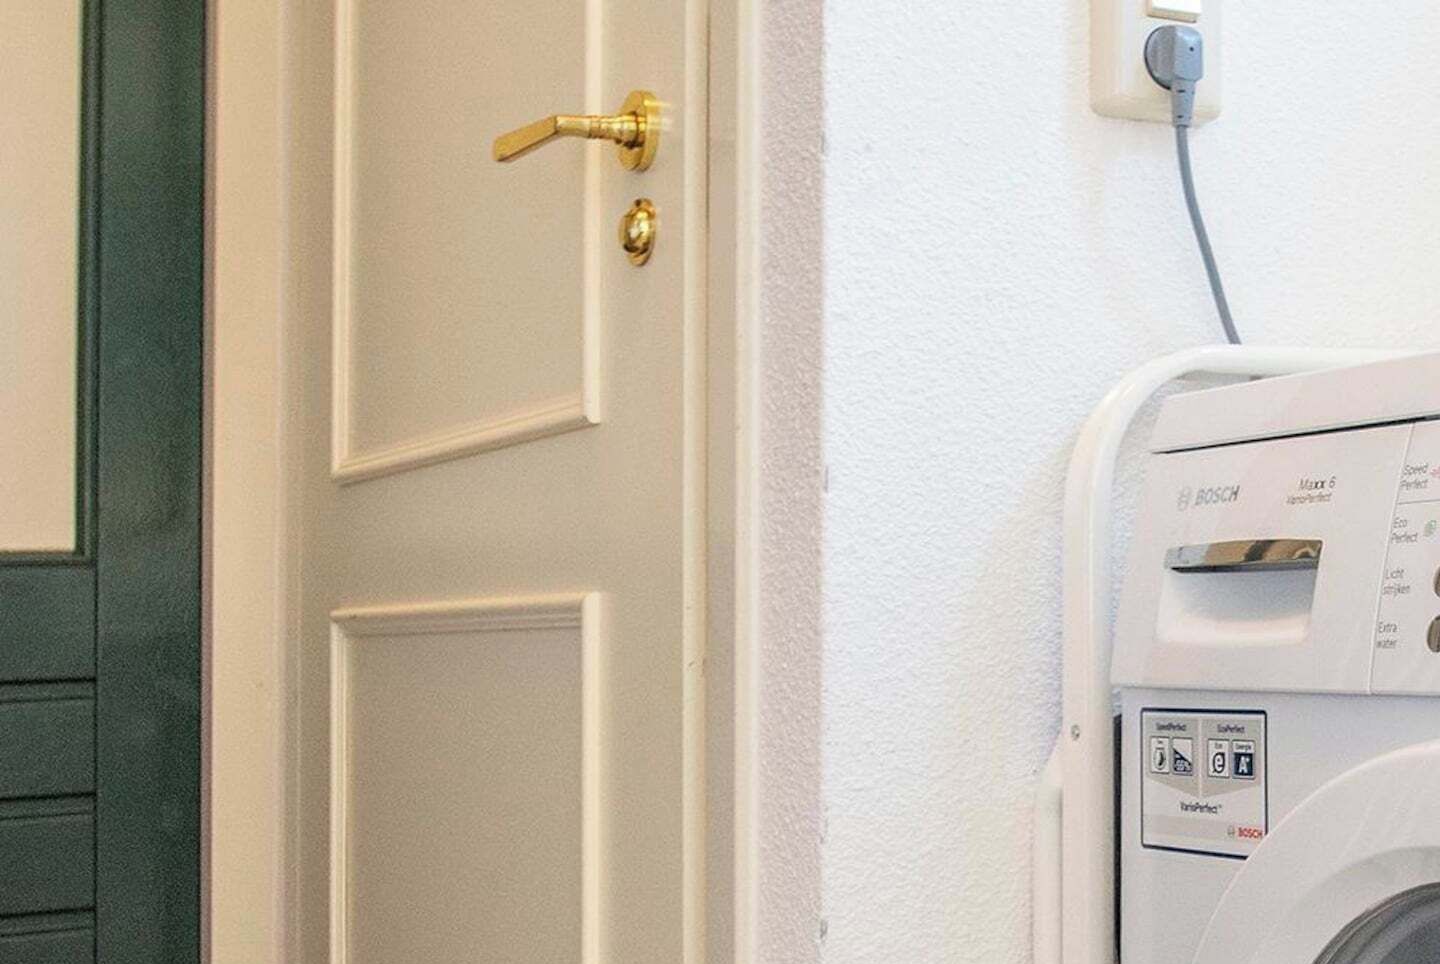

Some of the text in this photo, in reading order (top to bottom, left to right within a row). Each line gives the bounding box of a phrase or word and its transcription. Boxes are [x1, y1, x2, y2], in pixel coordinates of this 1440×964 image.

[1403, 463, 1429, 478] Speed
[1328, 476, 1337, 489] 6
[1401, 478, 1429, 491] Perfect
[1195, 484, 1241, 506] BOSCH
[1393, 517, 1408, 528] Eco
[1391, 532, 1418, 544] Perfect
[1378, 621, 1398, 634] Extra
[1237, 827, 1263, 839] BOSCH
